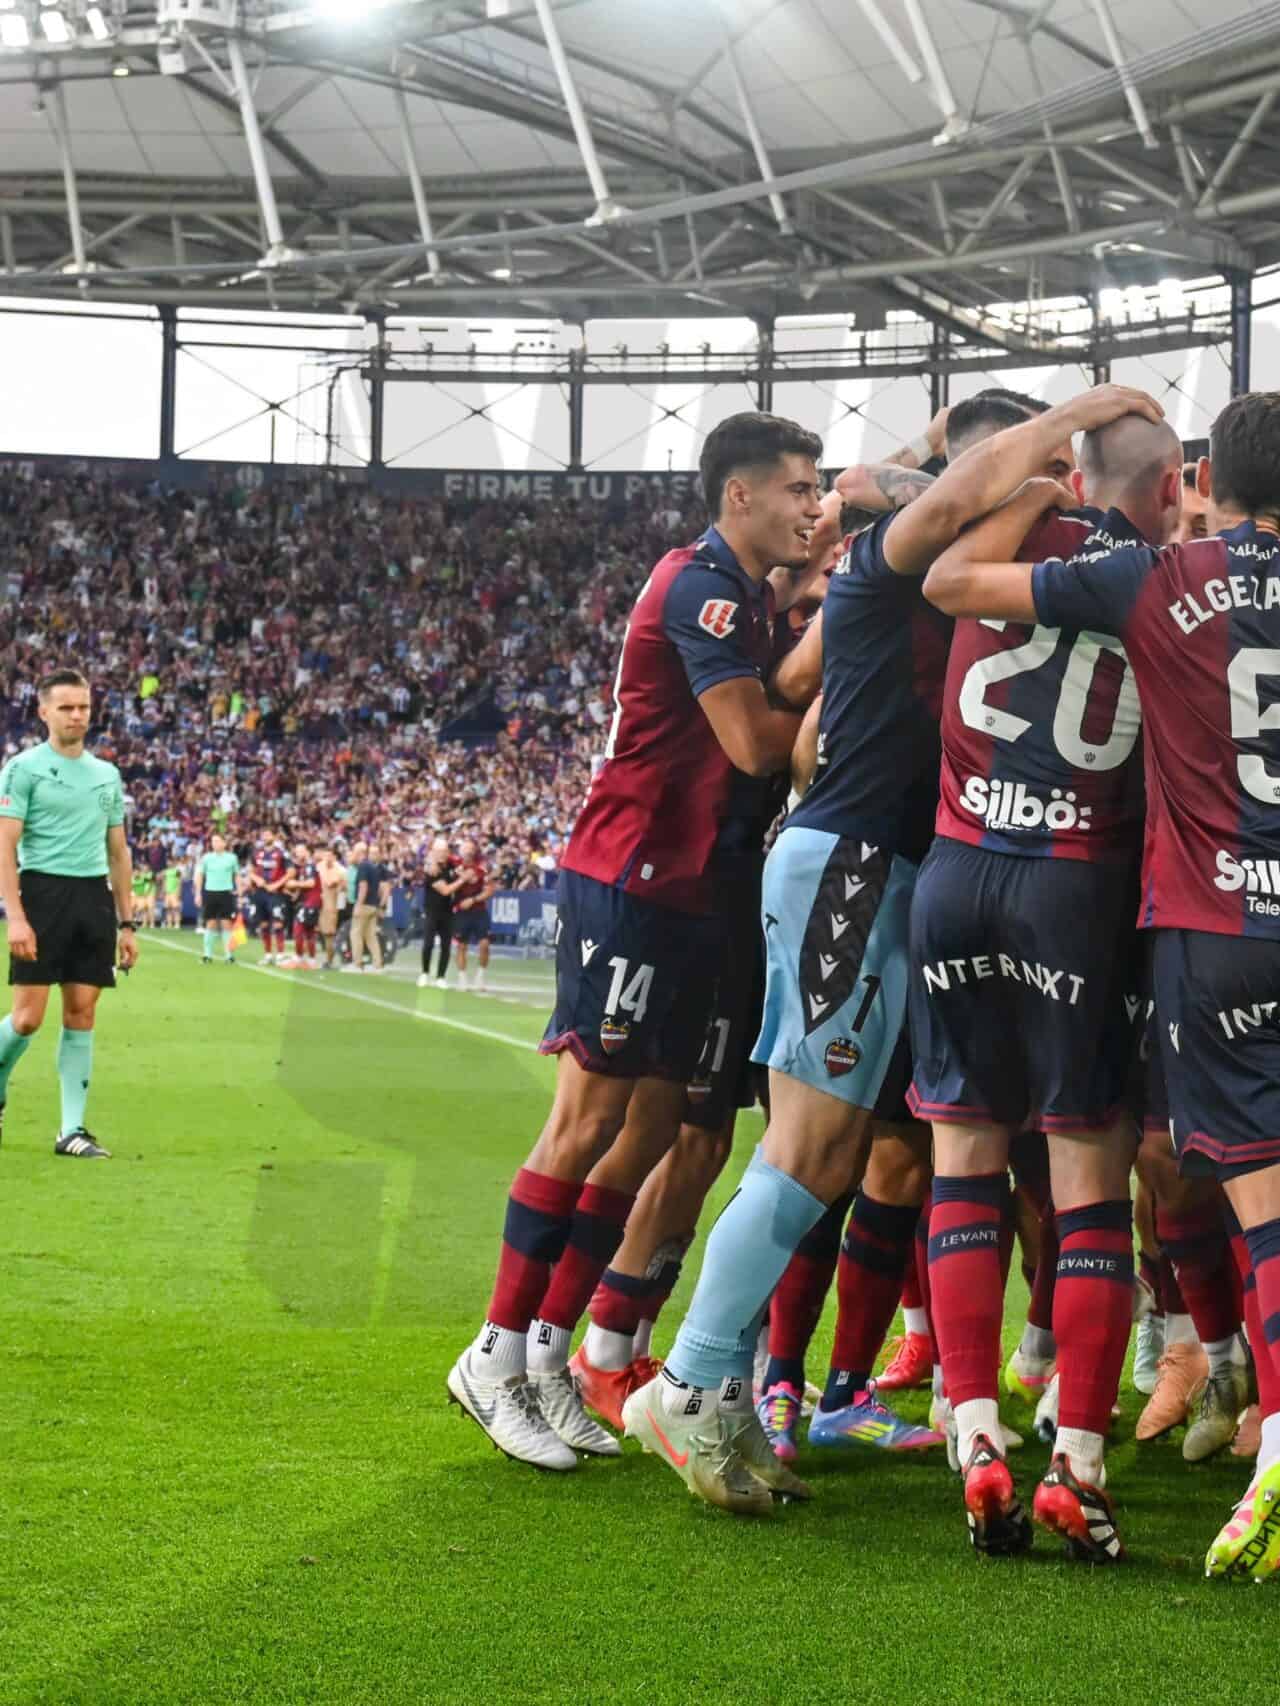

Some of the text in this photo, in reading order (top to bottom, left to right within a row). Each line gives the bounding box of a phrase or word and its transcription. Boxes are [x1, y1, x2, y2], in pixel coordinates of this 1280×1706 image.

[443, 473, 552, 500] FIRME
[566, 475, 611, 500] TU
[958, 619, 1142, 771] 20
[604, 955, 656, 1023] 14
[851, 974, 881, 1034] 1
[922, 953, 1085, 1006] NTERNXT
